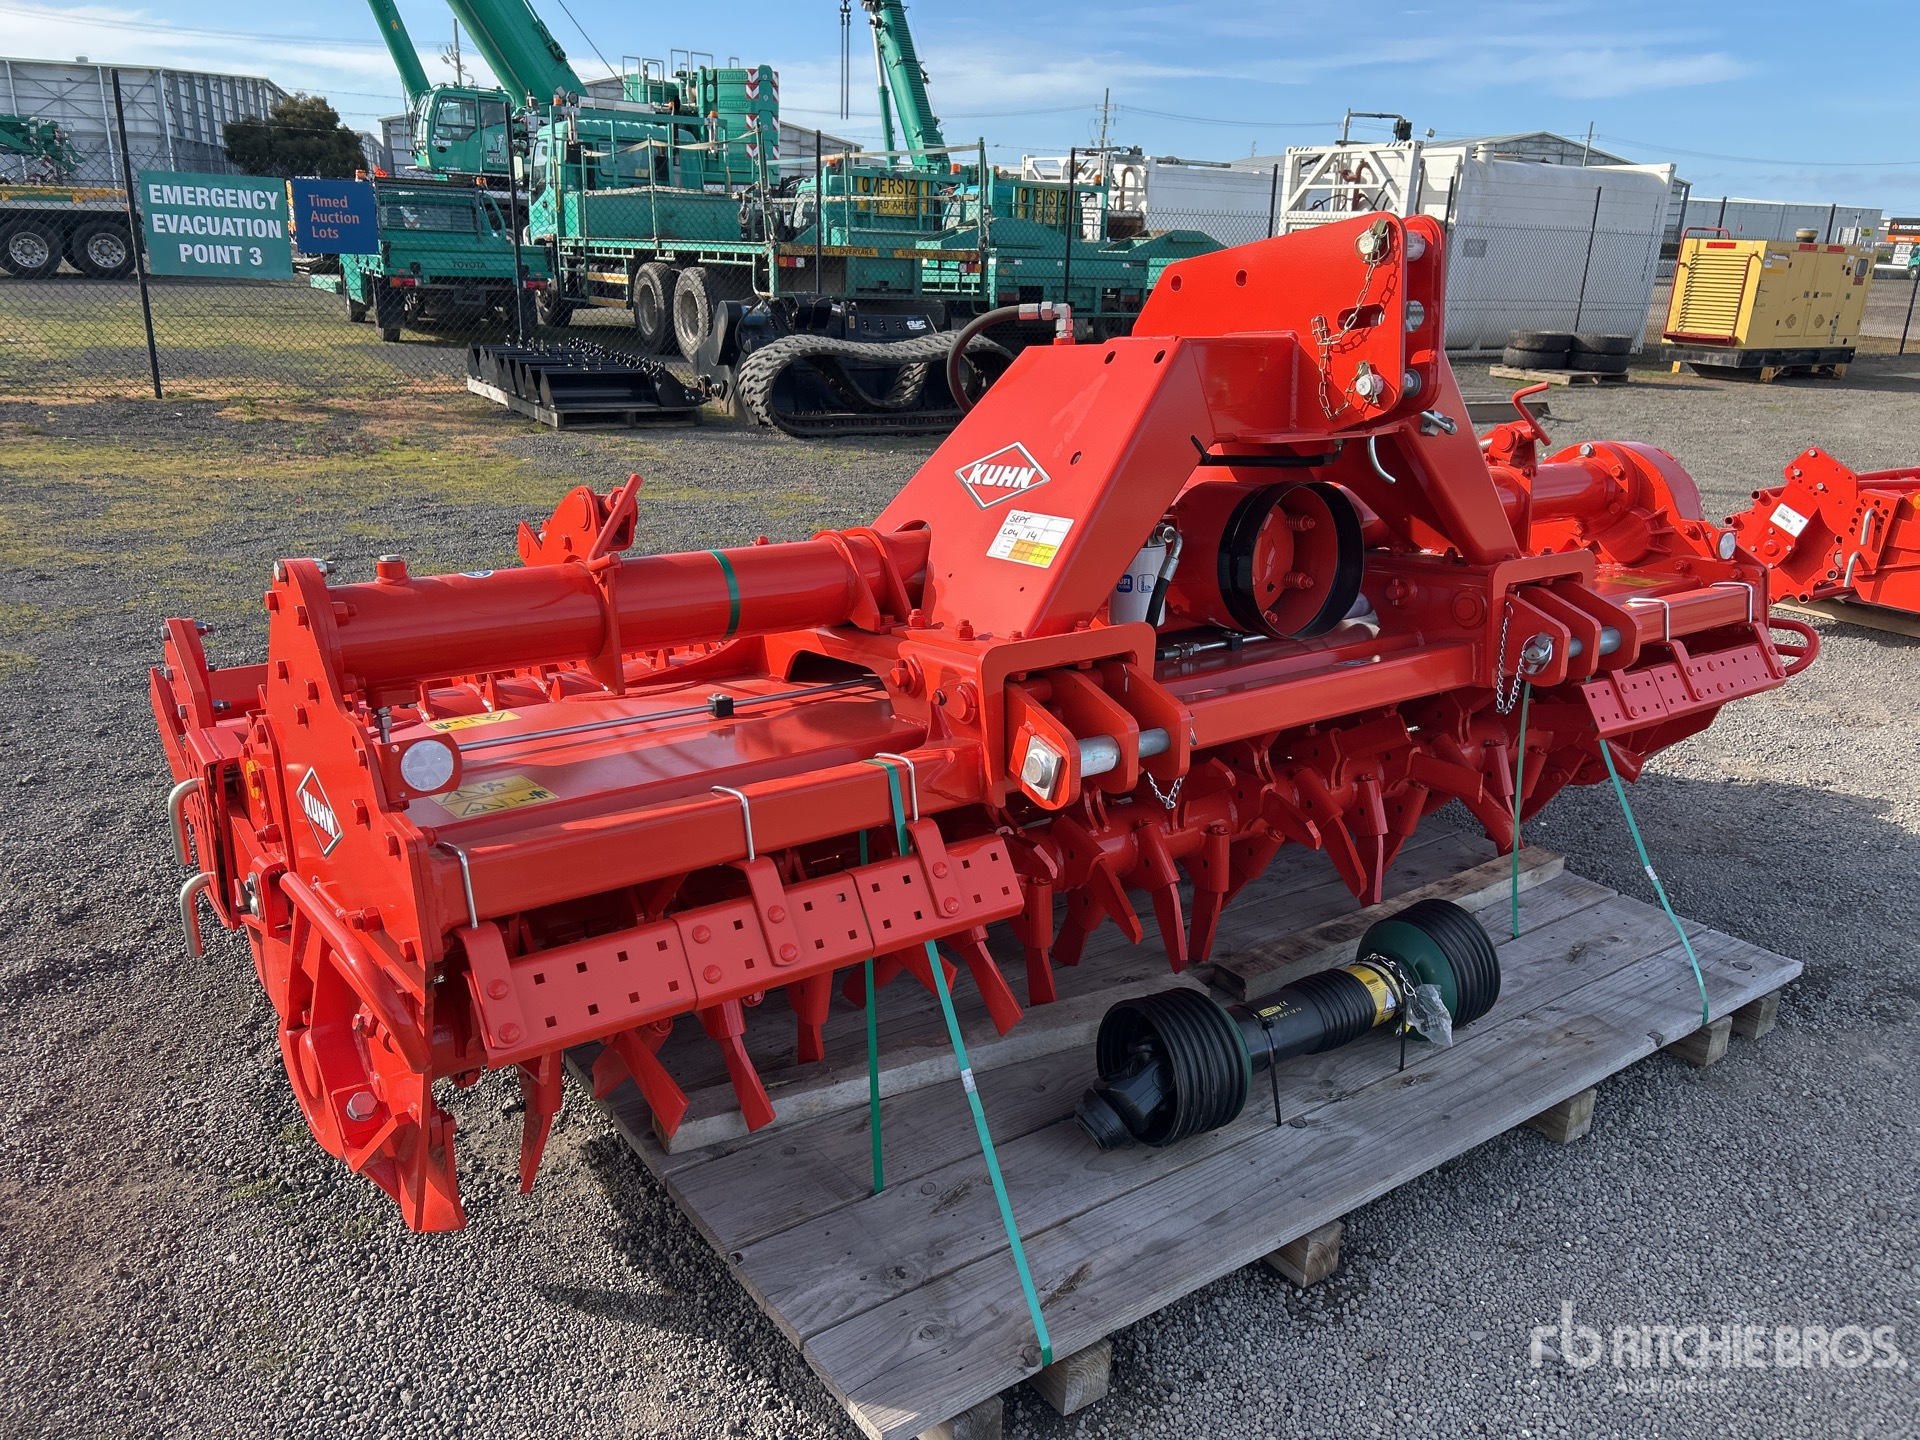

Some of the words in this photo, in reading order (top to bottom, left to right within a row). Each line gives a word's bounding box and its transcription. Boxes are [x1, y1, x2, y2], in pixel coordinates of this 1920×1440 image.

[862, 176, 917, 195] OVERSIZ
[148, 184, 278, 210] EMERGENCY
[308, 194, 348, 208] Timed
[310, 210, 360, 225] Auction
[151, 213, 282, 239] EVACUATION
[311, 226, 340, 239] Lots
[179, 243, 243, 265] POINT
[249, 247, 263, 266] 3
[840, 247, 874, 256] OVERTAKE
[901, 250, 928, 258] TURNING
[452, 260, 487, 269] TOYOTA
[967, 463, 1037, 489] KUHN
[1009, 514, 1031, 524] SEPT
[1026, 531, 1037, 541] 14
[302, 788, 336, 839] KUHN
